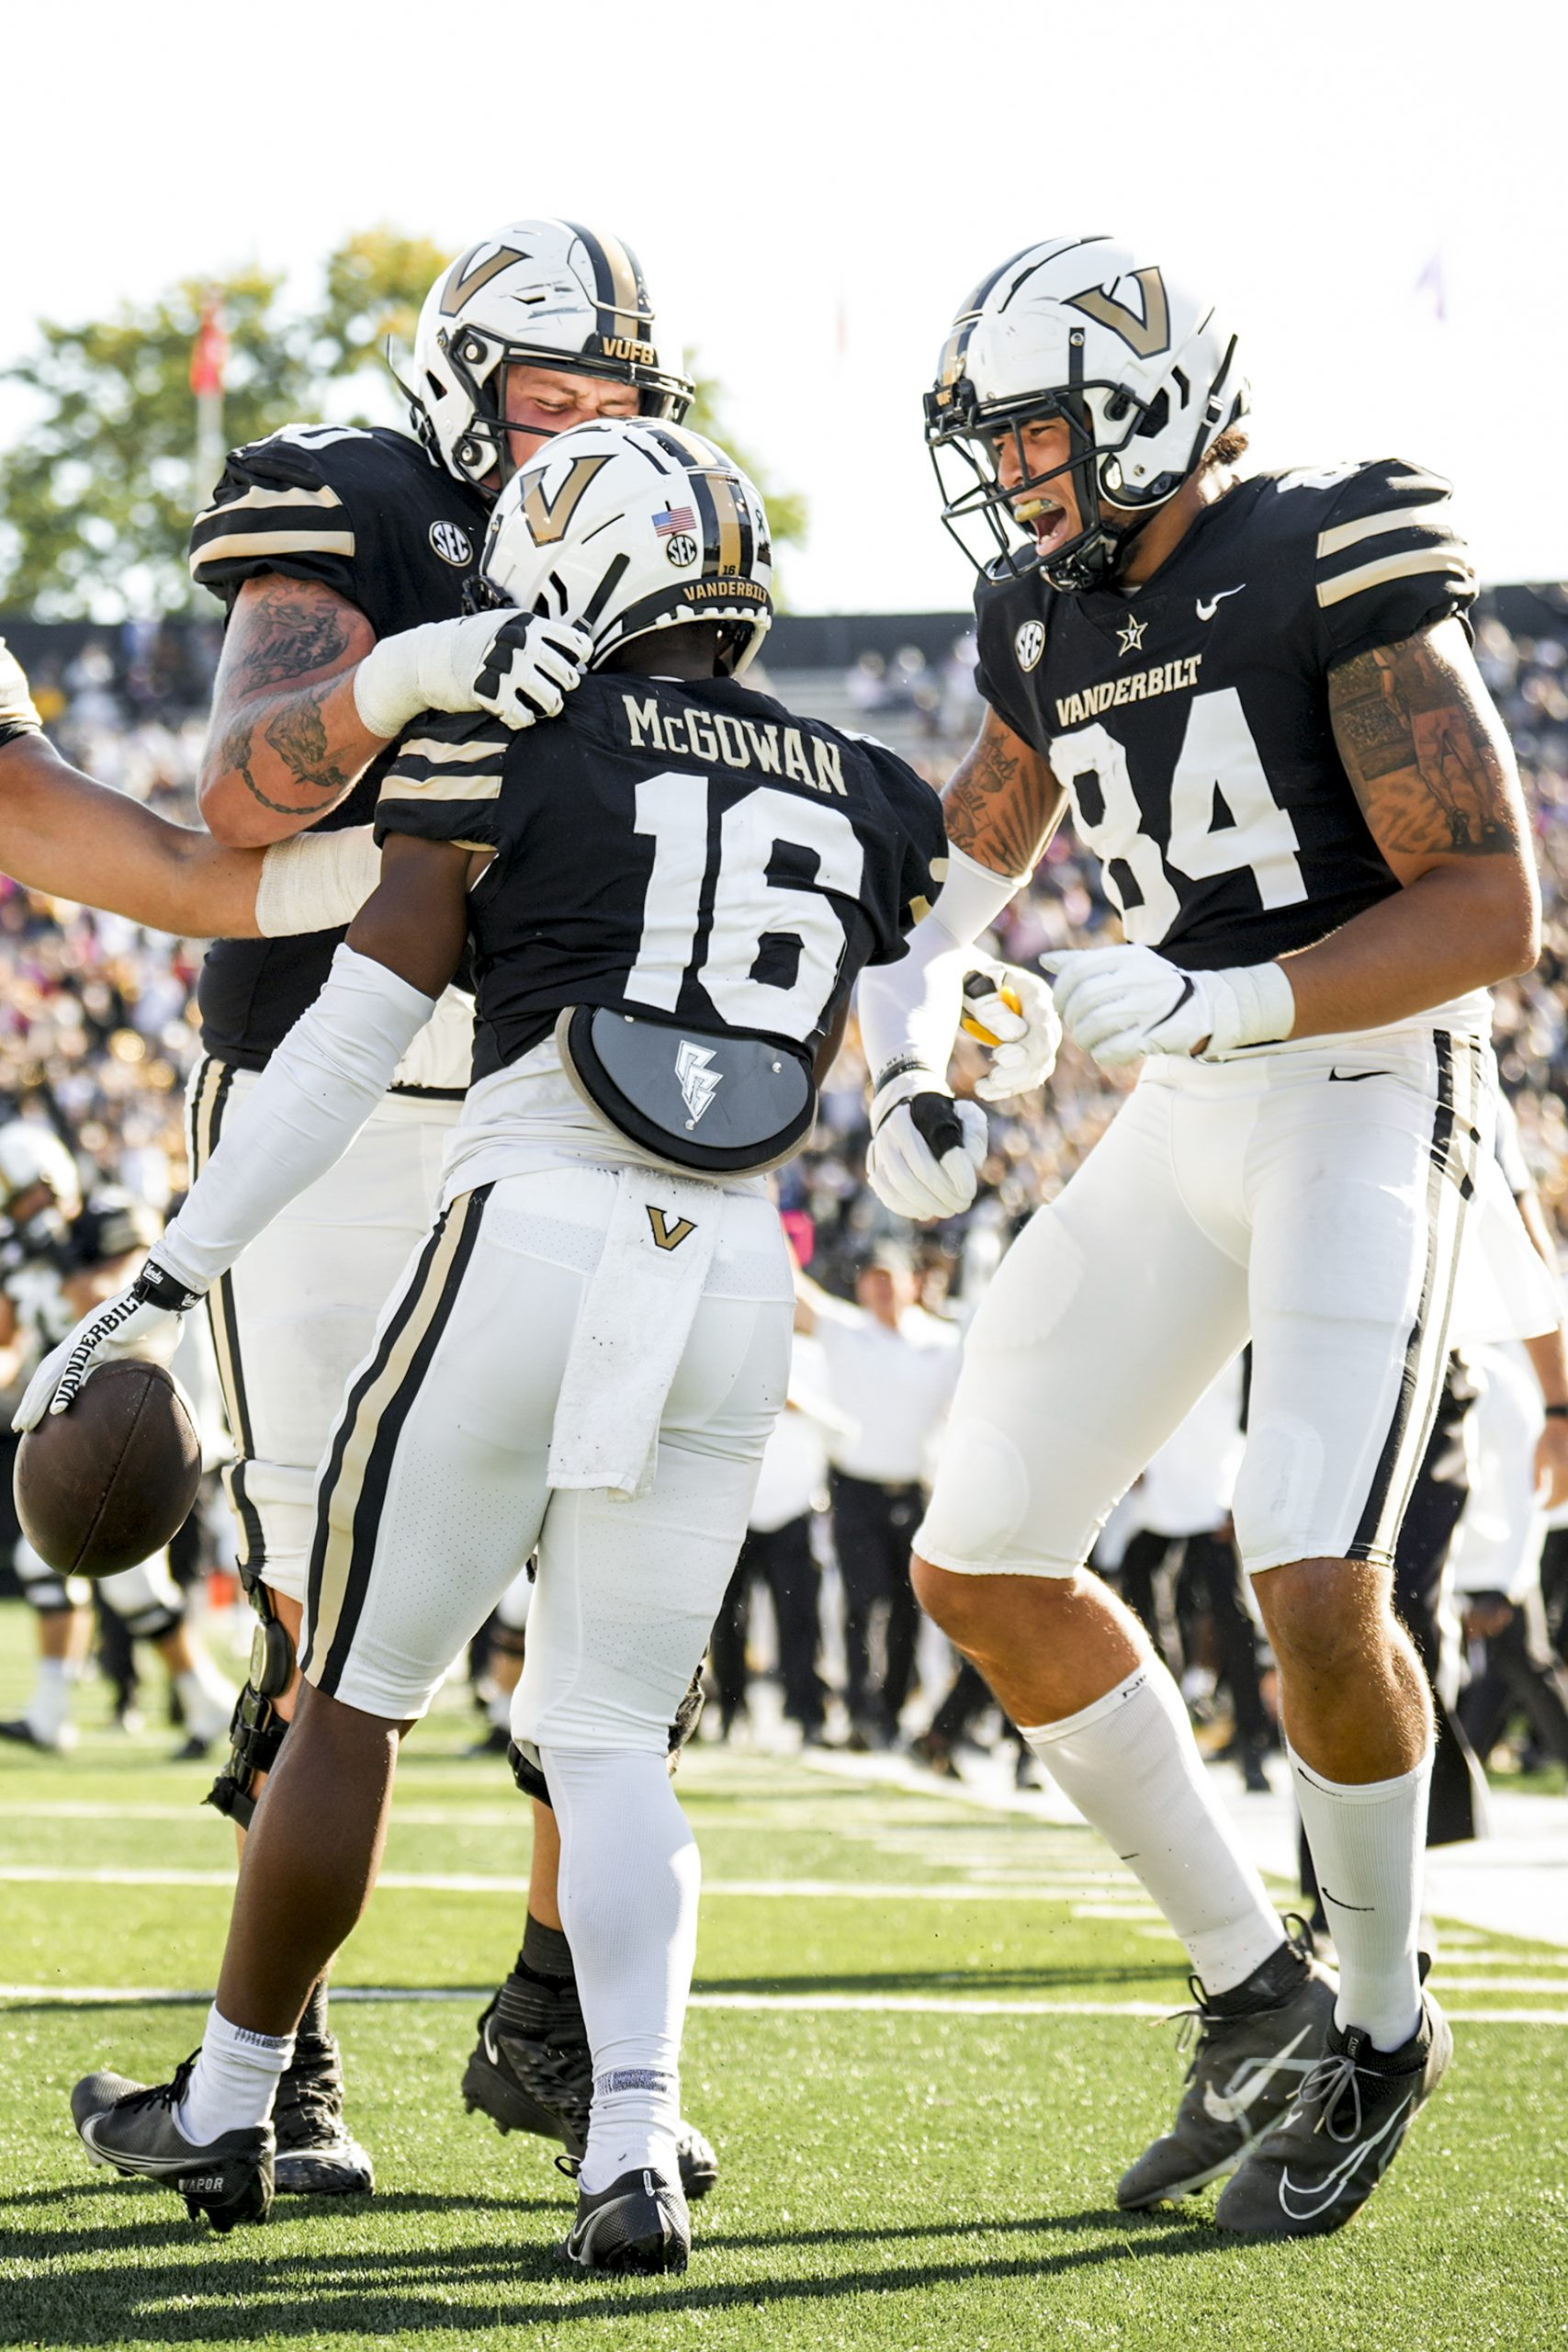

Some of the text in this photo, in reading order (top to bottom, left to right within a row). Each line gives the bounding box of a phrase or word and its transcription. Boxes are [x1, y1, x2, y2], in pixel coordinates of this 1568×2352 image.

[602, 336, 655, 366] VUFB
[433, 523, 469, 562] SEC
[667, 535, 697, 567] SEC
[722, 565, 737, 576] 16
[683, 582, 769, 604] VANDERBILT
[1015, 620, 1044, 672] SEC
[1056, 654, 1202, 727] VANDERBILT
[622, 695, 848, 797] McGOWAN
[1049, 687, 1308, 946] 84
[623, 772, 863, 1043] 16
[178, 2177, 223, 2193] VAPOR
